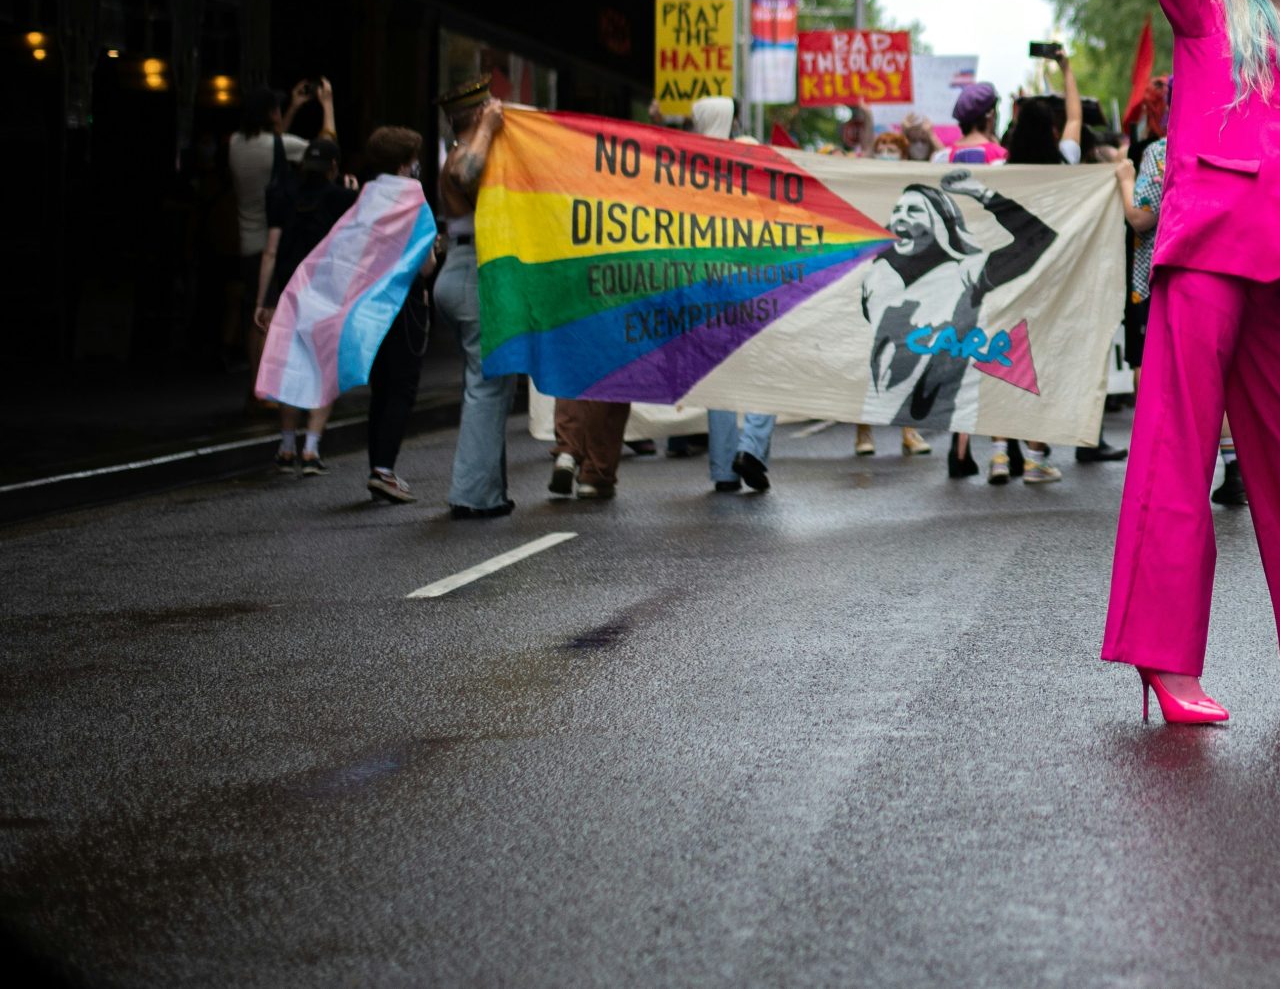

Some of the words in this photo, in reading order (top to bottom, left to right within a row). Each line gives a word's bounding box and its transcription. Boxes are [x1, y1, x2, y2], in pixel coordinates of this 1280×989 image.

[662, 2, 725, 28] PRAY
[674, 27, 719, 46] THE
[832, 33, 892, 53] BAD
[660, 47, 732, 71] HATE
[801, 51, 908, 75] THEOLOGY
[660, 77, 728, 100] AWAY
[595, 133, 642, 179] NO
[654, 144, 755, 197] RIGHT
[763, 167, 804, 204] TO
[572, 199, 824, 254] DISCRIMINATE!
[588, 260, 696, 297] EQUALITY
[704, 261, 807, 288] WITHOUT
[624, 298, 779, 344] EXEMPTIONS!
[905, 326, 1013, 368] CARR
